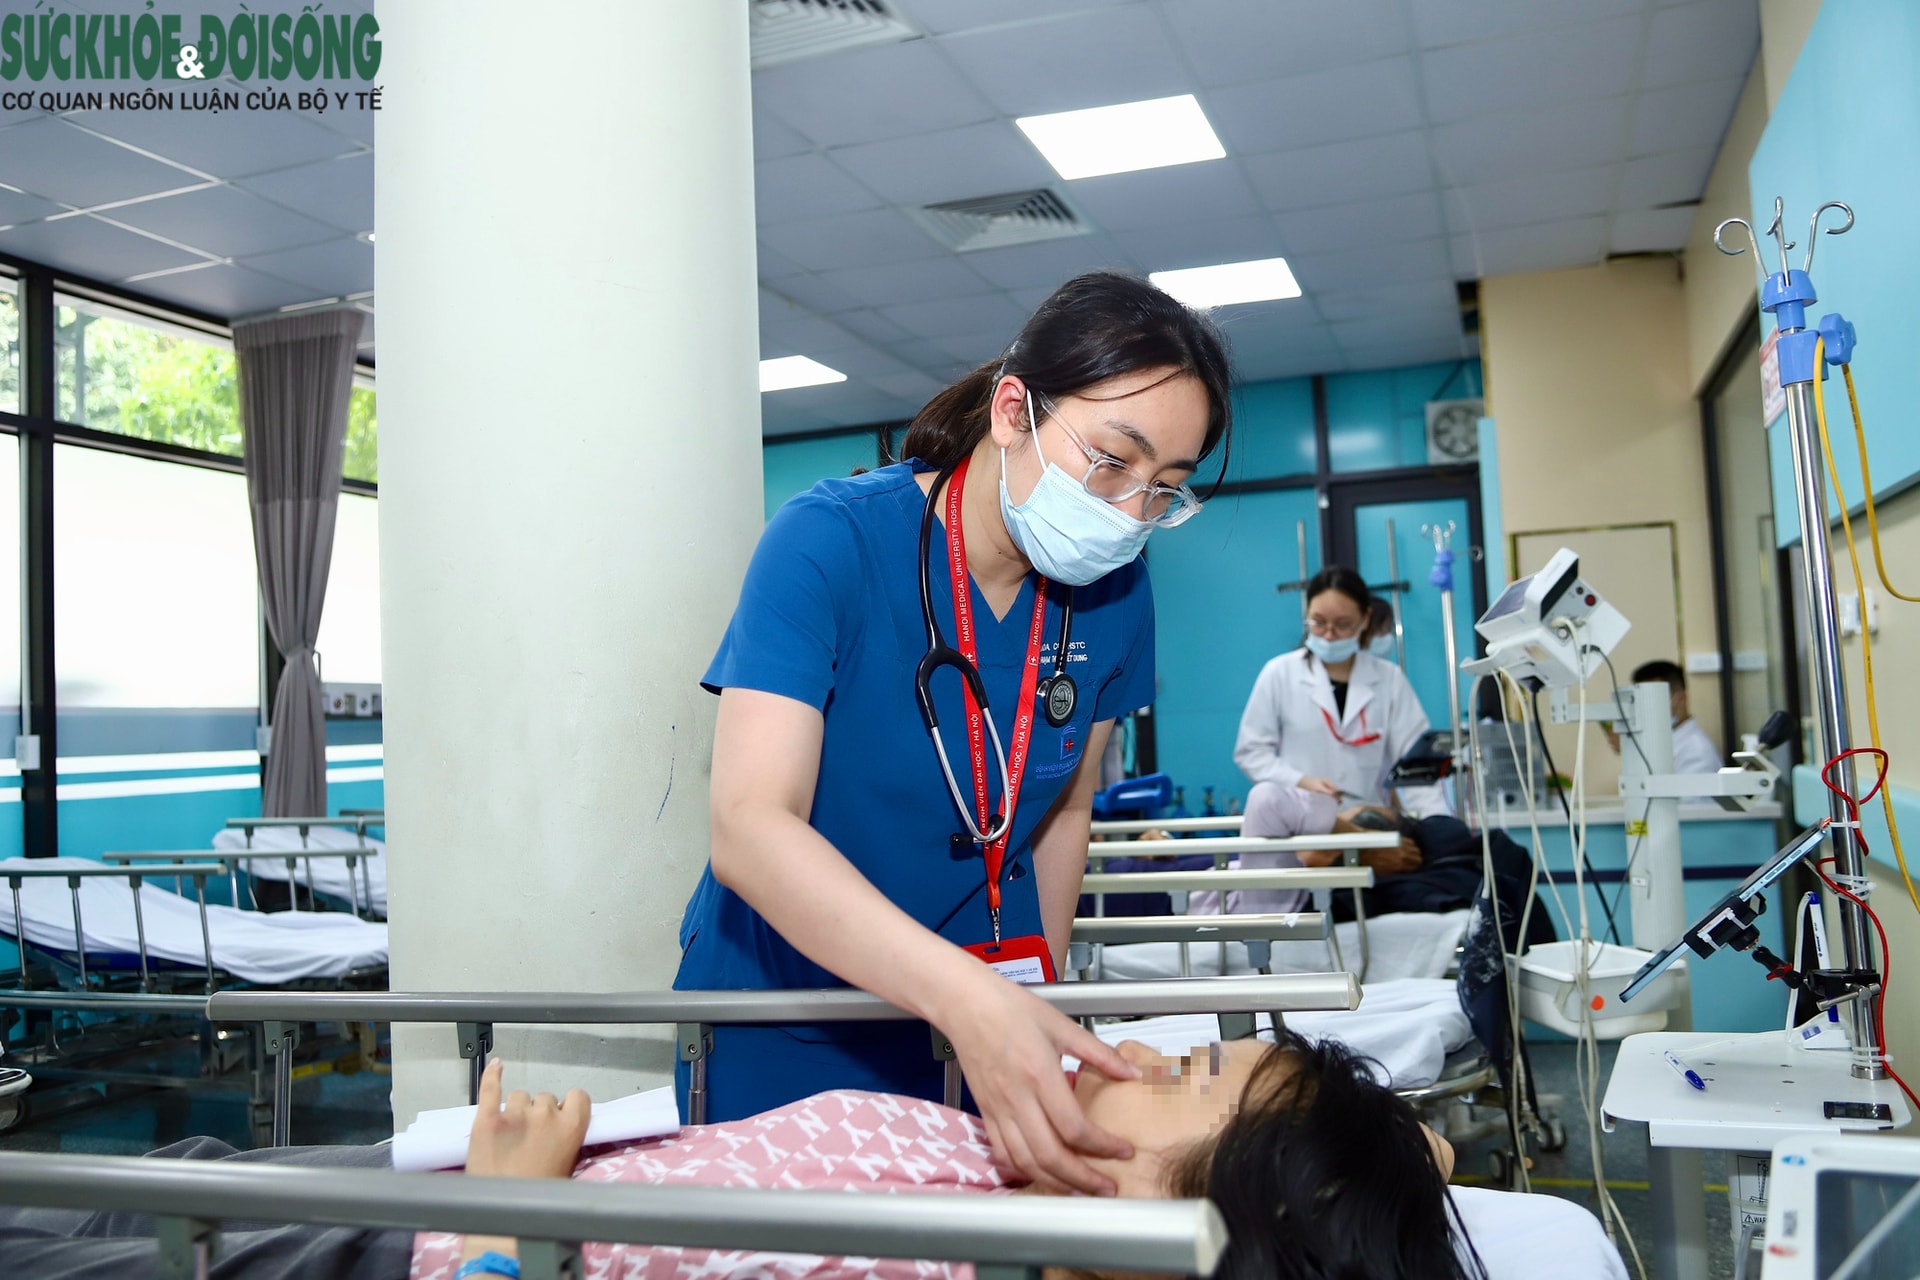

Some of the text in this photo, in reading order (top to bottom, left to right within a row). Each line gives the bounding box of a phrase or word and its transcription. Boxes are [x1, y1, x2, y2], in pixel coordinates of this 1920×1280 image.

[950, 487, 970, 642] HANOI MEDICAL UNIVERSITY HOSPITAL
[1036, 586, 1046, 619] MEDICAL
[970, 713, 979, 728] NỘI
[1014, 751, 1022, 769] HỌC
[1020, 714, 1029, 729] NỘI
